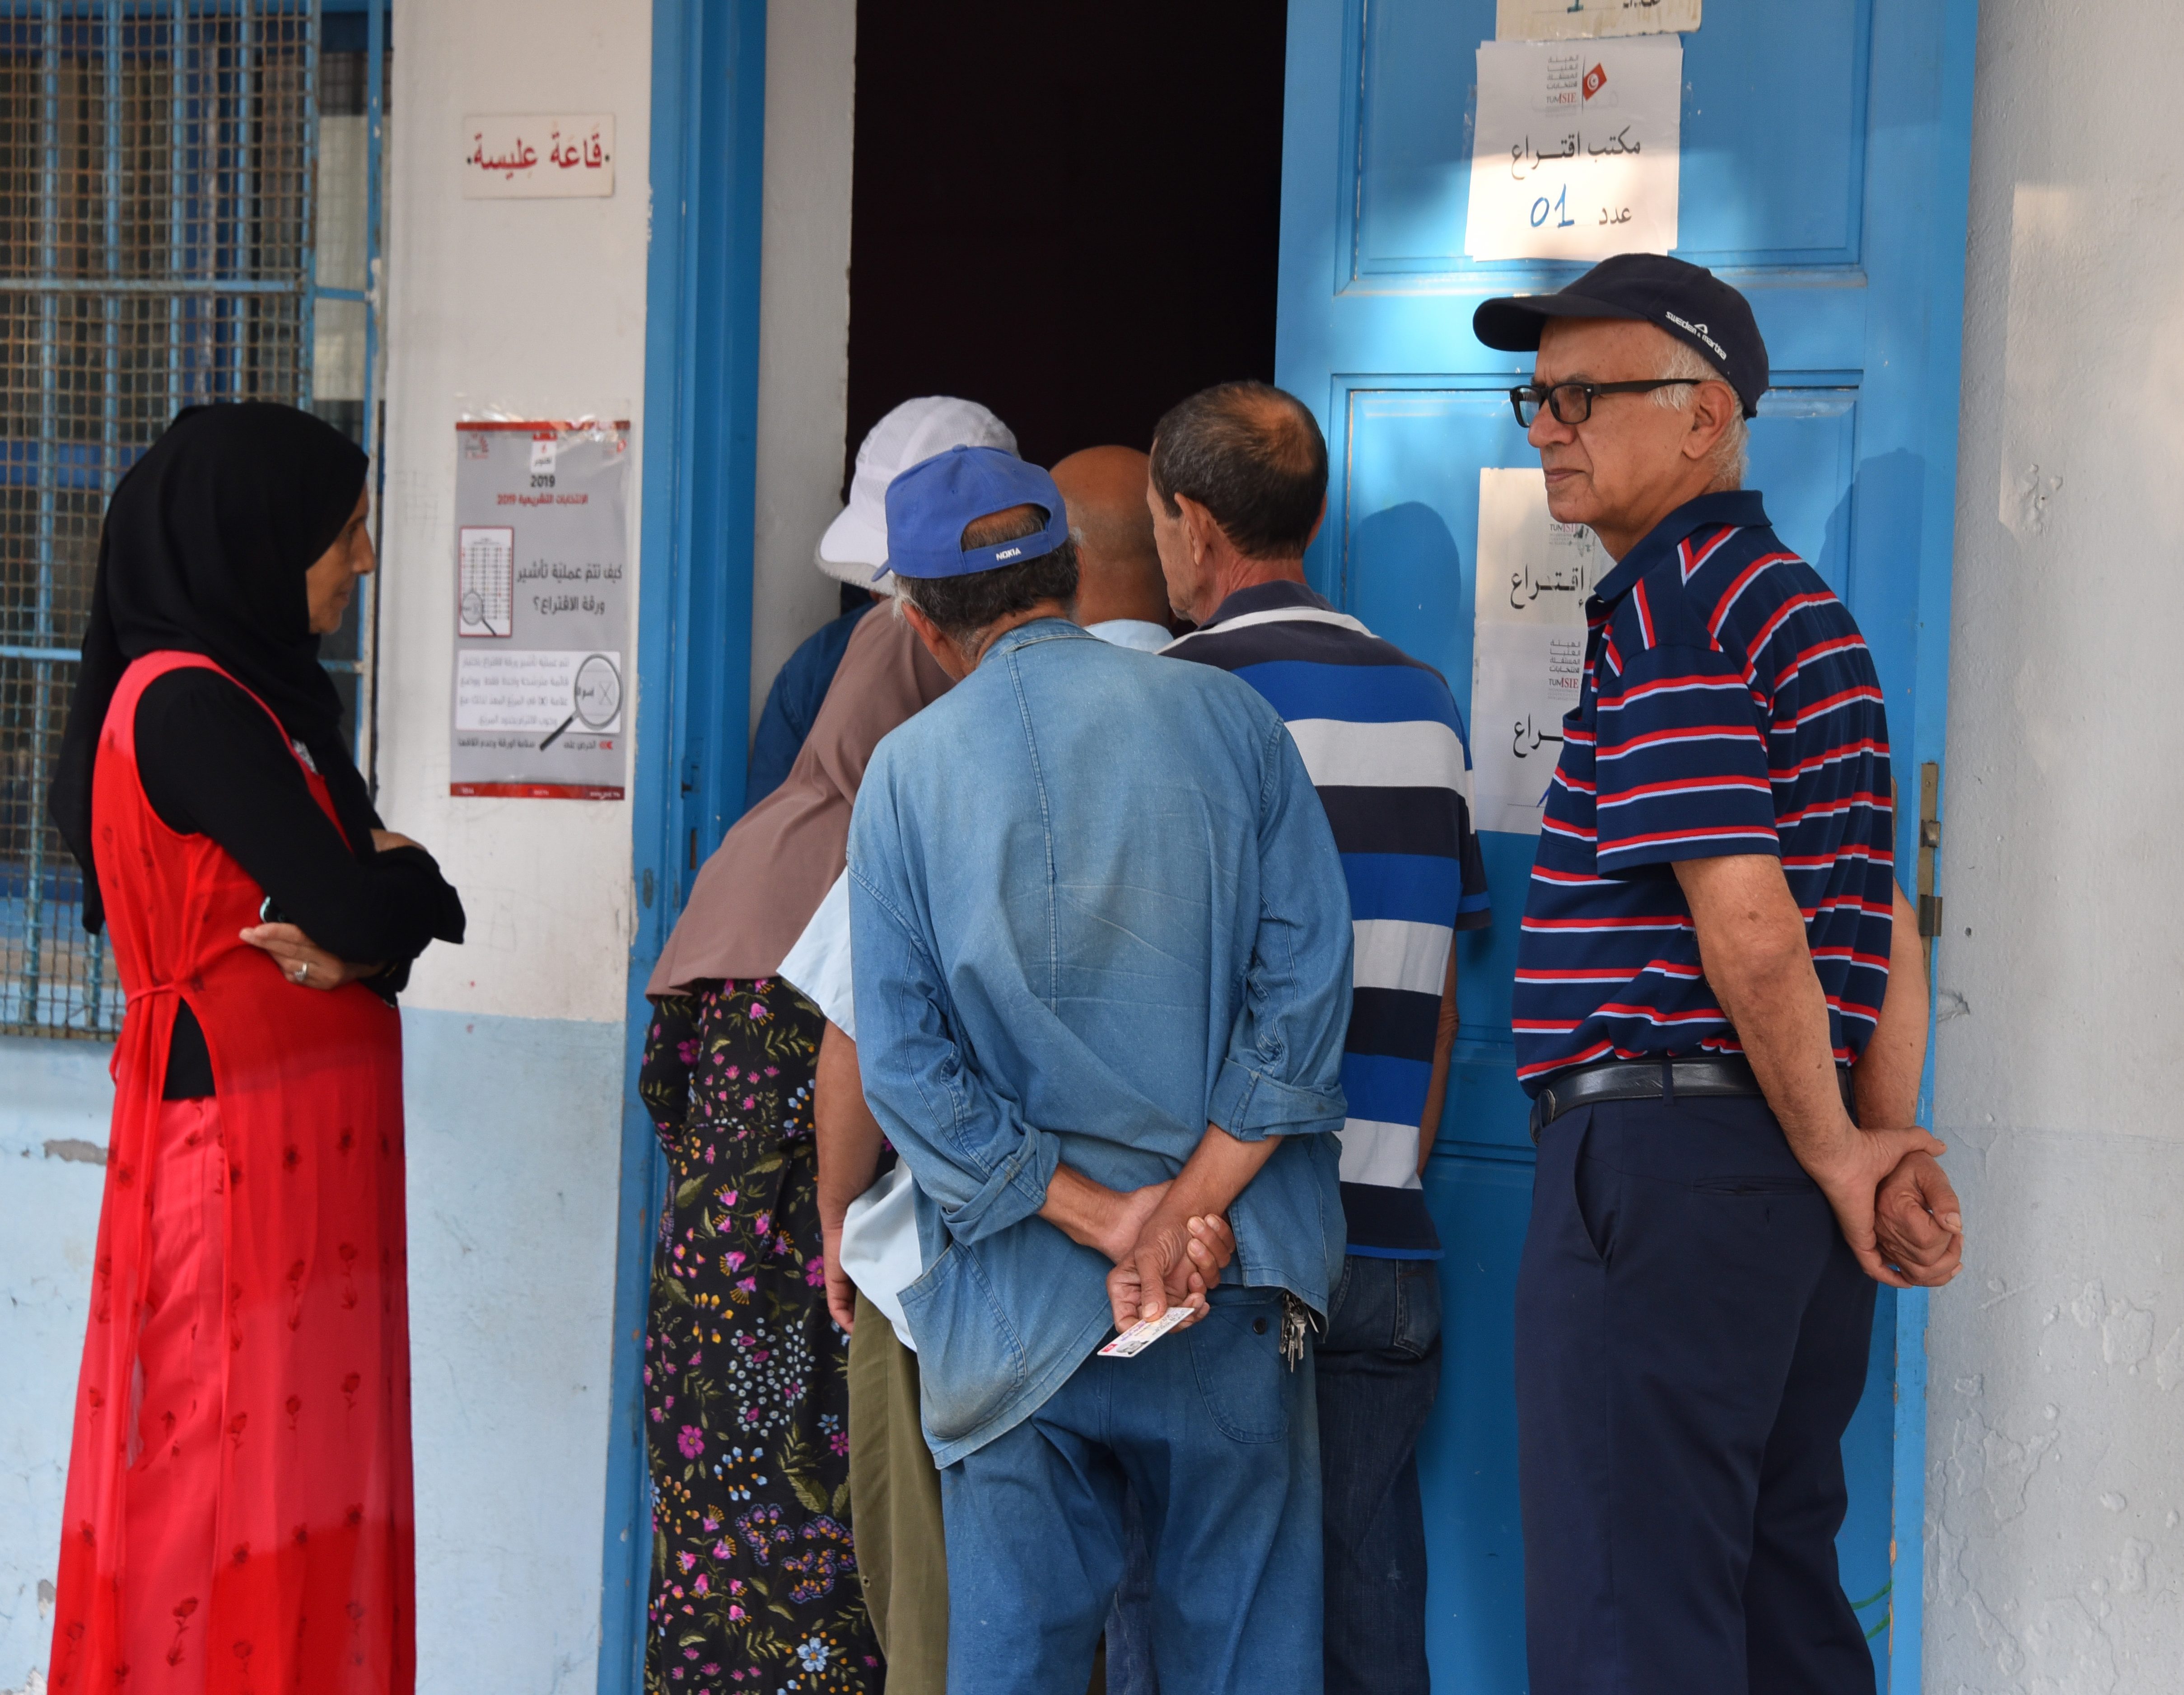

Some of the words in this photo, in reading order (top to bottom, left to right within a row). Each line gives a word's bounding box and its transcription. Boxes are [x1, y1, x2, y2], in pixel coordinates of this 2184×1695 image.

[550, 130, 602, 169] قاعة
[1587, 125, 1640, 163] مكتب
[1511, 131, 1581, 180] اقتراع
[1530, 182, 1575, 228] 01
[1599, 207, 1632, 226] عدد
[530, 474, 556, 488] 2019
[996, 546, 1022, 562] NOKIA
[603, 563, 623, 584] كيف
[582, 595, 606, 615] ورقة
[1548, 677, 1579, 689] TUNISIE
